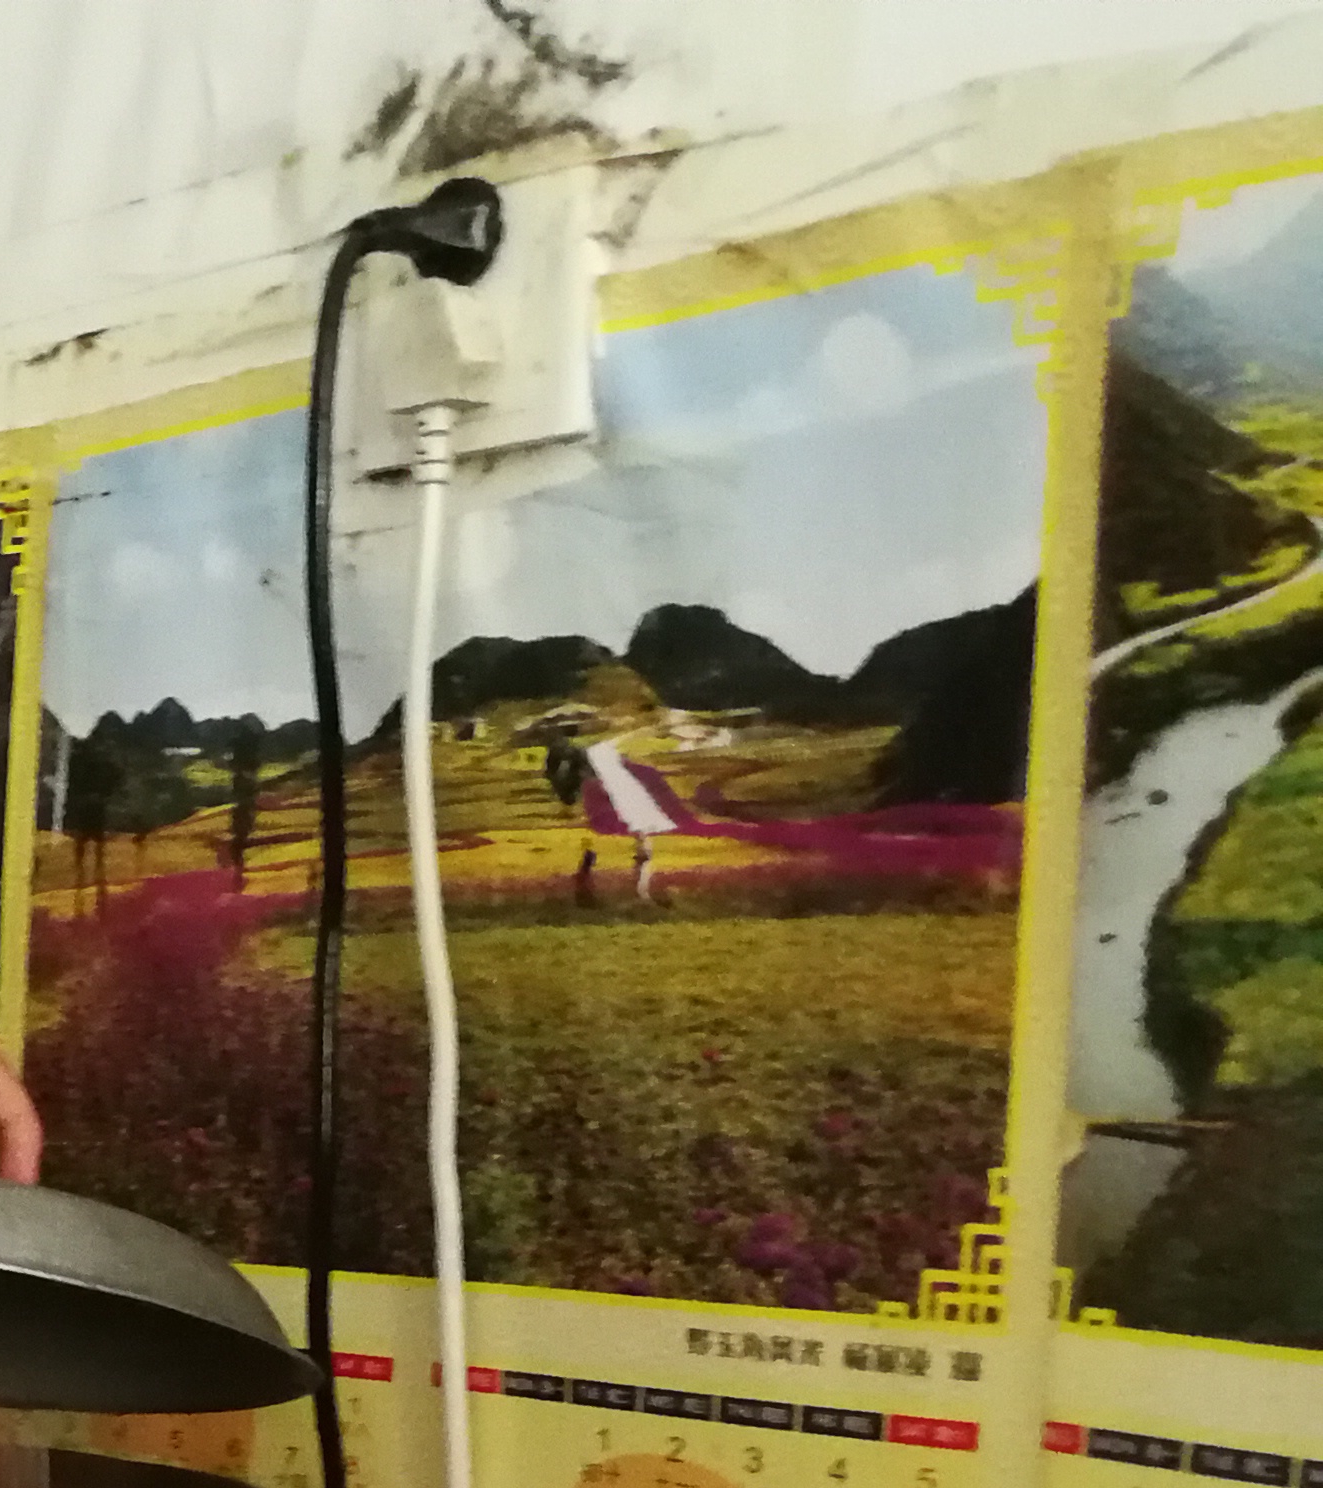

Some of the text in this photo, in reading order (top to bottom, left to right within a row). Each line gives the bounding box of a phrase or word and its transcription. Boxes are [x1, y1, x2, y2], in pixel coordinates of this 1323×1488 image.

[596, 1428, 609, 1453] 1
[666, 1436, 686, 1463] 2
[743, 1446, 764, 1474] 3
[828, 1458, 848, 1480] 4
